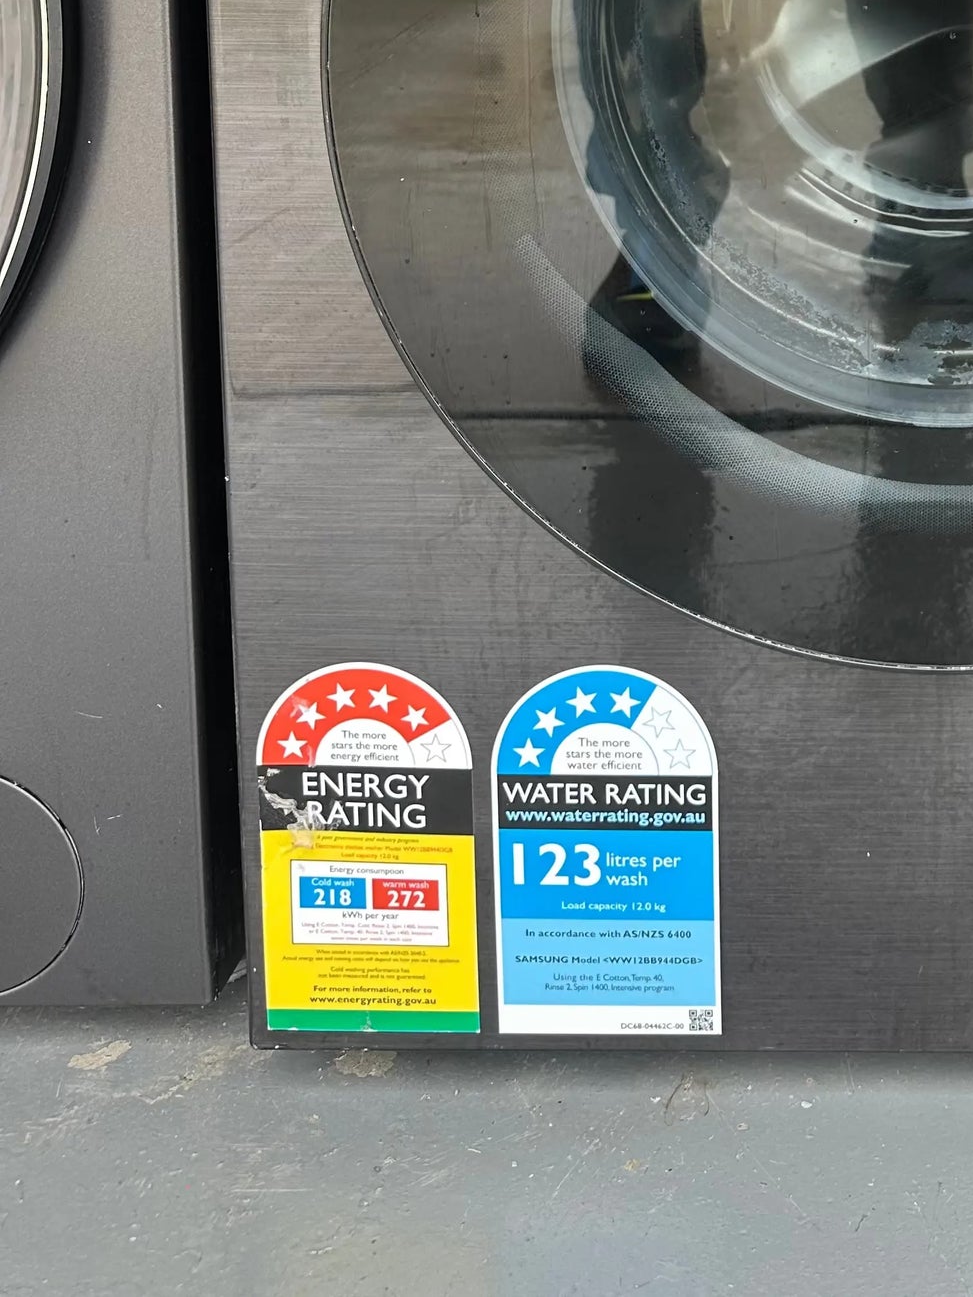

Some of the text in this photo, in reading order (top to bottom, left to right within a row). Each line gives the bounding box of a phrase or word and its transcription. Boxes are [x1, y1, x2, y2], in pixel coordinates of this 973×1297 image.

[341, 730, 360, 739] The
[331, 742, 353, 750] stars
[356, 741, 371, 750] the
[578, 737, 630, 747] The more
[330, 752, 399, 762] energy efficient
[566, 749, 643, 759] stars the more
[567, 760, 642, 770] water efficient
[302, 772, 430, 800] ENERGY
[502, 782, 706, 806] WATER RATING
[306, 801, 427, 829] RATING
[505, 808, 706, 827] www.waterrating.gov.au
[512, 842, 682, 887] 123 litres per
[329, 865, 404, 876] Energy consumption
[311, 878, 355, 887] Cold wash
[606, 871, 648, 886] wash
[382, 880, 430, 889] warm wash
[314, 888, 352, 906] 218
[387, 890, 426, 908] 272
[561, 901, 667, 913] Load capacity 12.0 kg
[342, 911, 363, 919] kWh
[381, 913, 400, 921] year
[525, 928, 692, 940] In accordance with AS/NZS 6400
[515, 955, 569, 964] SAMSUNG
[571, 955, 601, 964] Model
[553, 973, 577, 982] Using
[579, 973, 594, 981] the
[596, 974, 601, 982] E
[544, 983, 565, 991] Rinse
[574, 983, 589, 992] Spin
[611, 984, 642, 992] Intensive
[643, 985, 675, 993] program
[310, 995, 437, 1006] www.energyrating.gov.au
